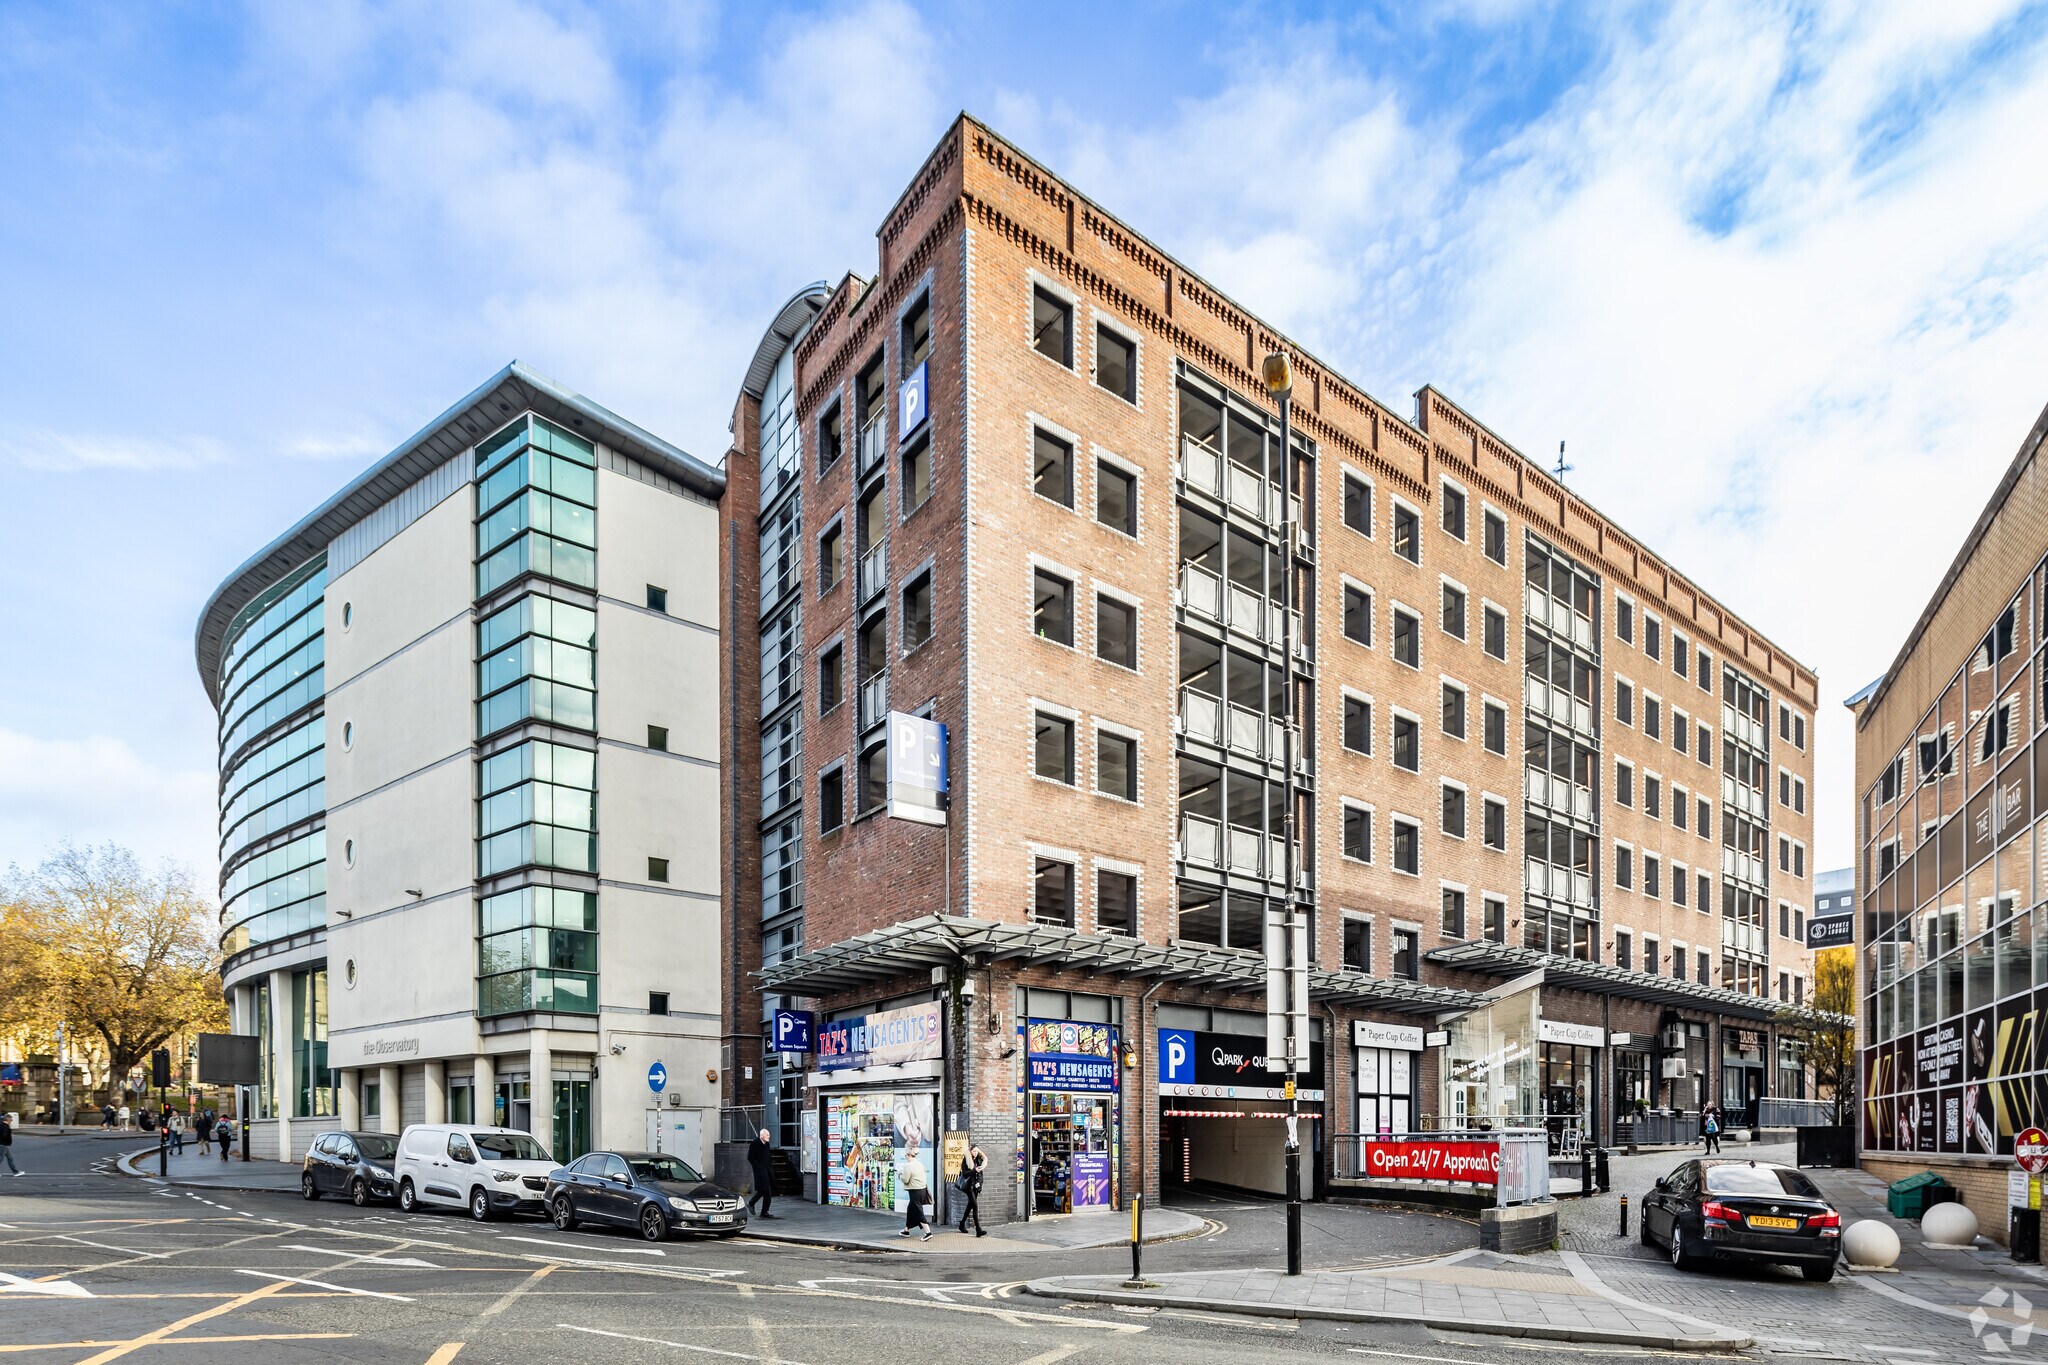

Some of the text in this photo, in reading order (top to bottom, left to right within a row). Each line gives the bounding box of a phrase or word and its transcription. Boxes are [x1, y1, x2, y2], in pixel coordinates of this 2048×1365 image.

[906, 387, 918, 430] P
[900, 724, 916, 759] P
[1976, 815, 1988, 837] THE
[2007, 787, 2021, 812] BAR
[1828, 922, 1849, 930] SPORTS
[1828, 927, 1849, 936] LOUNGE
[779, 1017, 793, 1041] P
[820, 1015, 925, 1057] TAZ'S NEWSAGENTS
[1368, 1029, 1384, 1042] Paper
[1386, 1031, 1398, 1043] Cup
[1399, 1032, 1418, 1043] Coffee
[1550, 1026, 1594, 1041] Paper Cup Coffee
[1739, 1031, 1758, 1044] TAPAS
[1924, 1027, 1954, 1046] GENTIN CASINO
[363, 1036, 419, 1055] the Observatory
[1169, 1043, 1186, 1079] P
[1452, 1065, 1468, 1076] This
[1484, 1052, 1496, 1064] for
[1497, 1041, 1518, 1057] great
[1469, 1047, 1532, 1079] coffee and snacks
[1945, 1053, 1959, 1066] MINUTE
[1032, 1061, 1112, 1078] TAZ'S NEWSAGENTS
[1929, 1068, 1950, 1082] WAL AWAY
[1373, 1150, 1408, 1171] Open
[1411, 1148, 1440, 1171] 24/7
[1443, 1150, 1489, 1175] Approach
[1754, 1216, 1791, 1227] YD13 SVC
